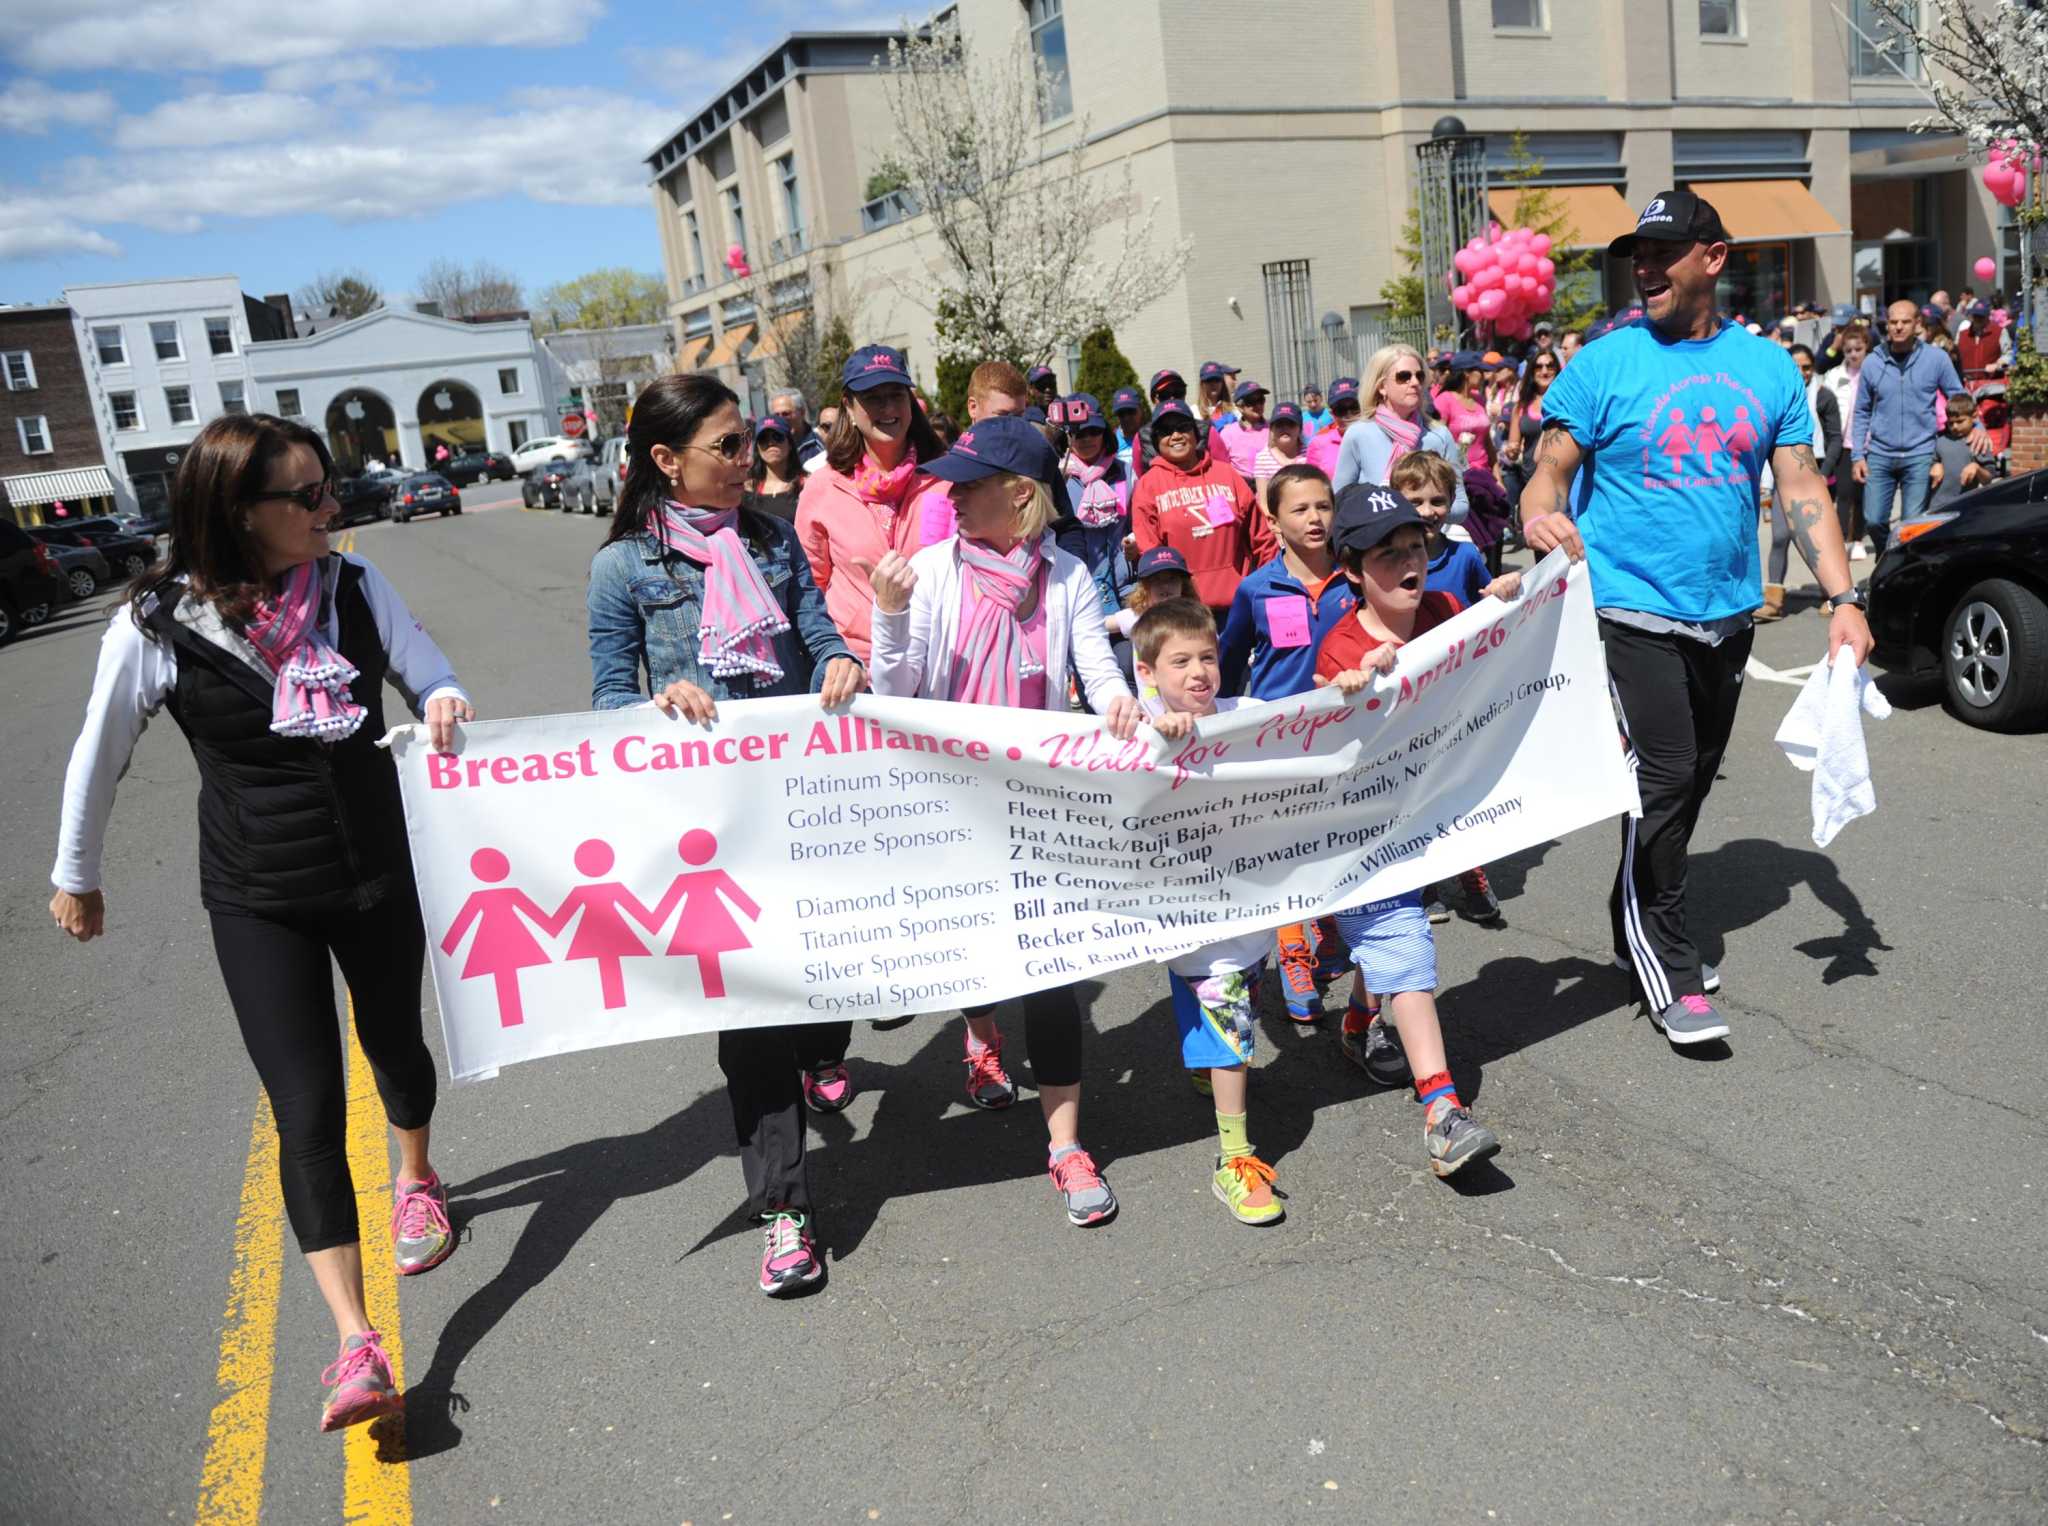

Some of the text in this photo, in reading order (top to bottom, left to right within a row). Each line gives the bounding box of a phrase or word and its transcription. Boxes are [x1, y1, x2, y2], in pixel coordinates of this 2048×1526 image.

[1367, 491, 1398, 513] NY
[427, 738, 598, 790] Breast
[612, 730, 789, 773] Cancer
[804, 716, 990, 761] Alliance
[1040, 728, 1157, 773] Walk
[1172, 735, 1231, 790] for
[1395, 639, 1465, 707] April
[1010, 825, 1047, 843] Hat
[1053, 832, 1169, 854] Attack/Buji
[1177, 822, 1223, 845] Baja,
[1229, 814, 1264, 829] The
[1342, 774, 1399, 806] Family,
[1466, 691, 1514, 737] Medical
[1516, 672, 1572, 701] Group,
[785, 767, 979, 797] Platinum Sponsor:
[1006, 779, 1112, 805] Omnicom
[788, 799, 949, 829] Gold Sponsors:
[1008, 801, 1056, 821] Fleet
[1066, 808, 1114, 830] Feet,
[1122, 797, 1233, 831] Greenwich
[1241, 778, 1329, 806] Hospital,
[790, 827, 973, 861] Bronze Sponsors:
[1009, 845, 1212, 870] Z Restaurant Group
[1010, 814, 1410, 891] The Genovese Family/Baywater Properti
[1018, 927, 1085, 950] Becker
[1092, 918, 1152, 940] Salon,
[1157, 909, 1217, 930] White
[1225, 901, 1280, 920] Plains
[1360, 831, 1433, 873] Williams
[1436, 823, 1450, 839] &
[1452, 795, 1523, 831] Company
[796, 879, 999, 918] Diamond Sponsors:
[1014, 889, 1231, 921] Bill and Fran Deutsch
[800, 911, 996, 950] Titanium Sponsors:
[804, 948, 968, 984] Silver Sponsors:
[1088, 947, 1138, 965] Rand
[808, 976, 987, 1014] Crystal Sponsors:
